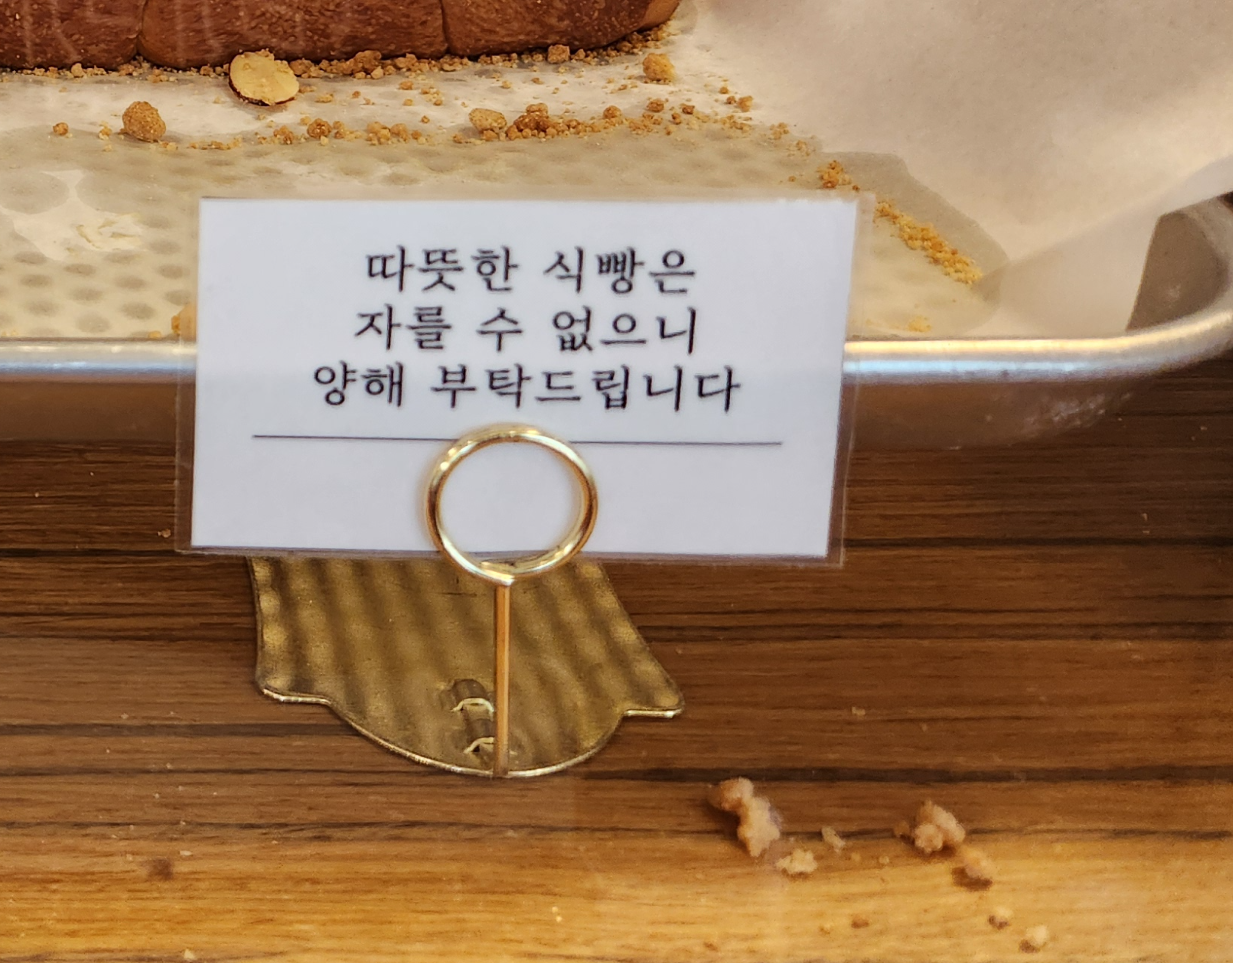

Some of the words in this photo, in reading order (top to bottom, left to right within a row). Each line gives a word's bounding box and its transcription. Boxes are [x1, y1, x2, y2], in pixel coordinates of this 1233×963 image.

[366, 245, 519, 293] 따뜻한
[543, 247, 696, 295] 식빵은
[353, 303, 453, 351] 자를
[476, 307, 524, 352] 수
[551, 306, 698, 355] 없으니
[313, 361, 405, 408] 양해
[430, 363, 742, 413] 부탁드립니다
